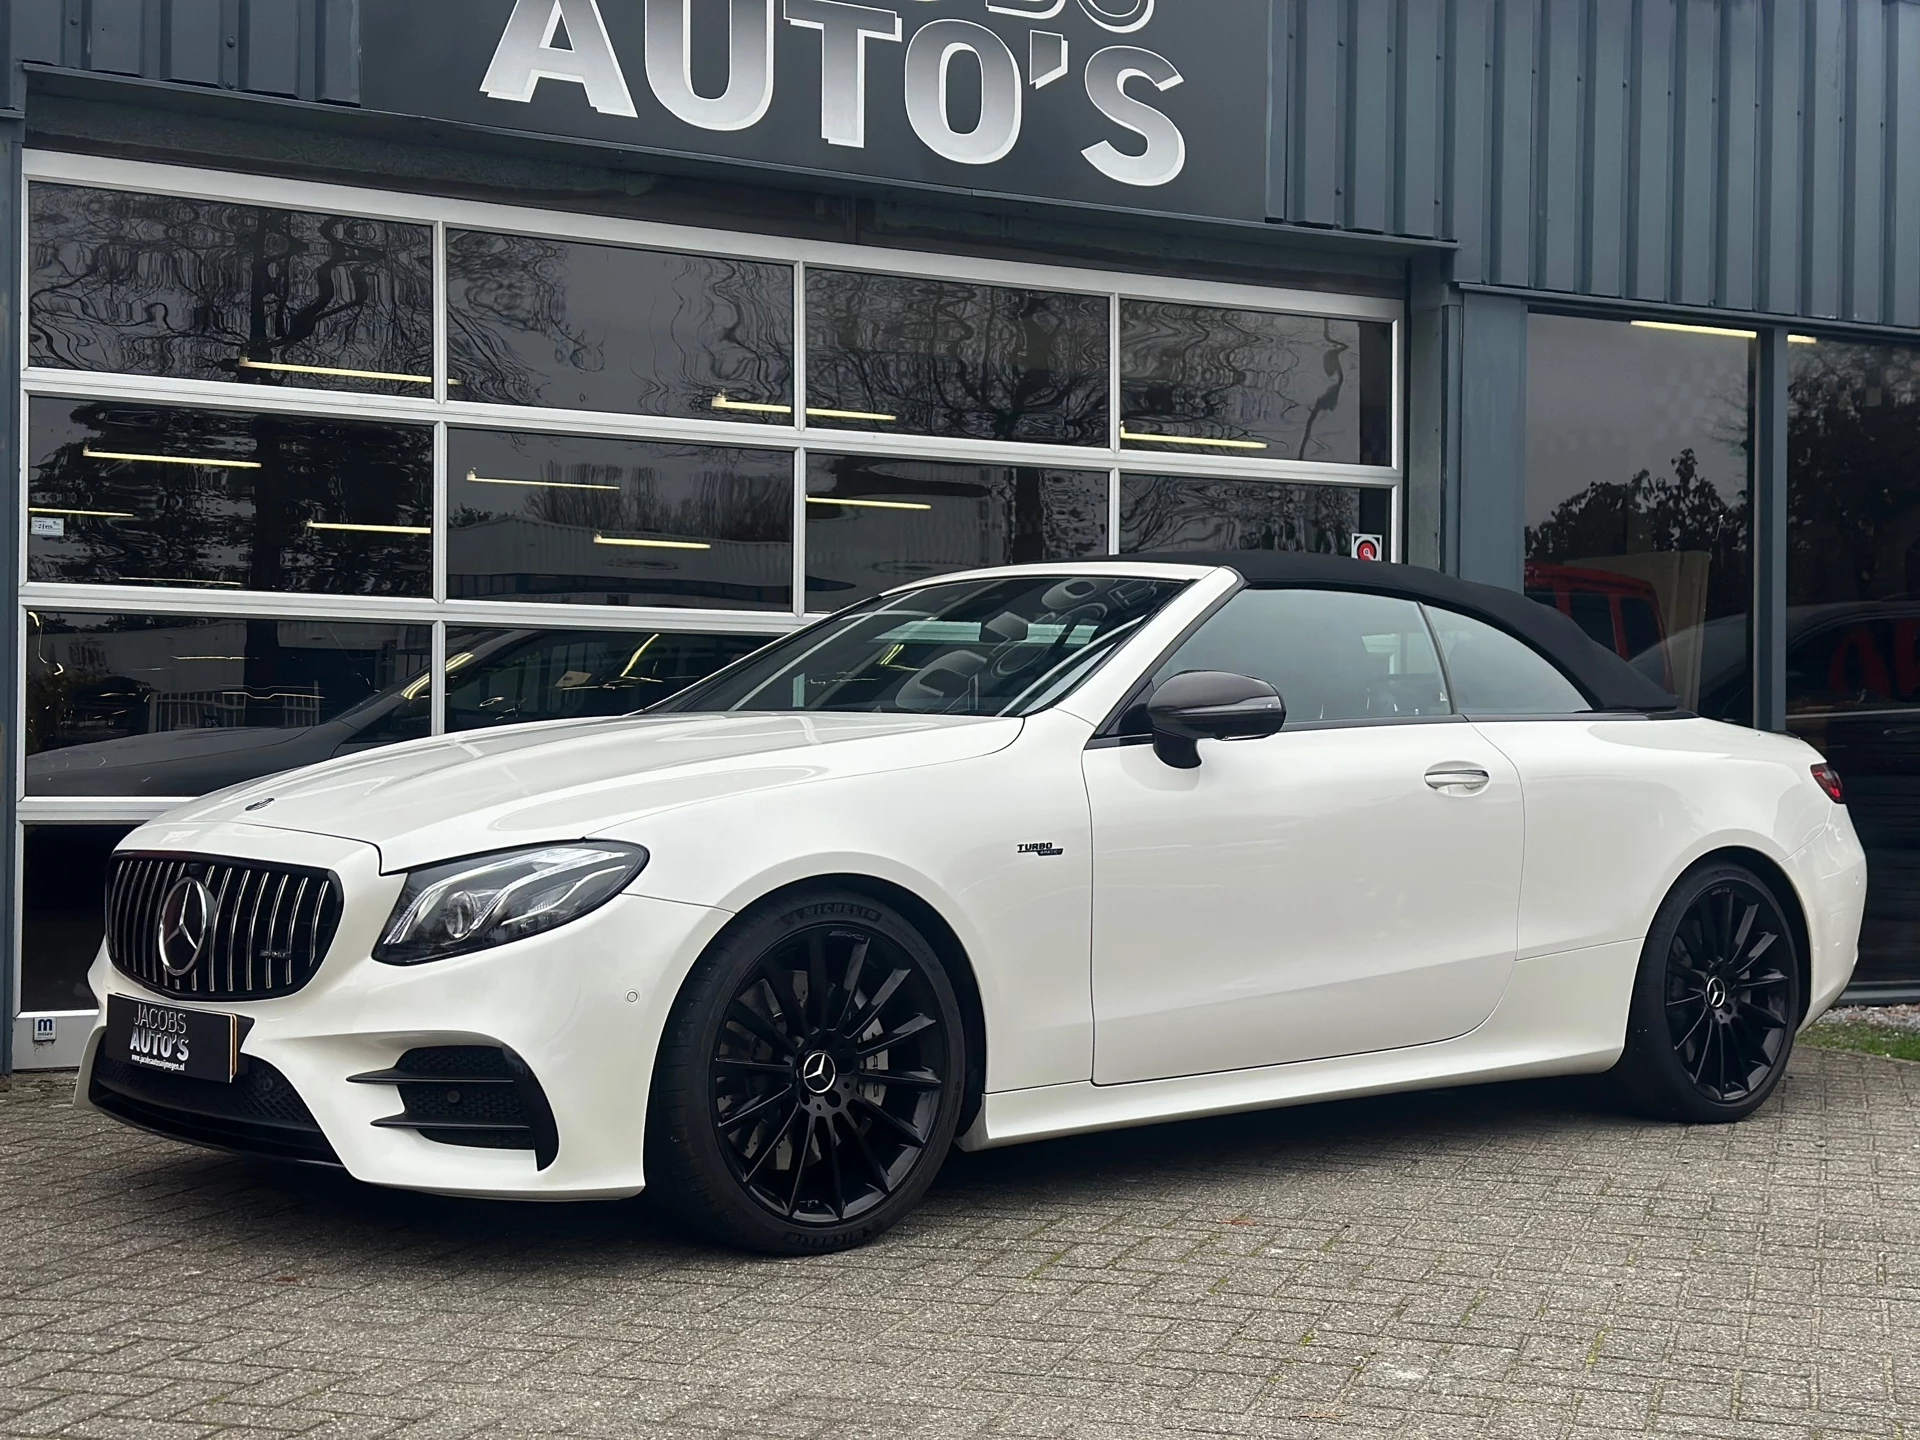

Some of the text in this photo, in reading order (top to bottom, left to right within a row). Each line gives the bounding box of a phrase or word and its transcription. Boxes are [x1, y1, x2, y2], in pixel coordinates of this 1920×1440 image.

[479, 0, 1186, 187] AUTO'S
[1017, 841, 1053, 850] TURBO
[803, 903, 877, 920] MICHELIN
[133, 1003, 187, 1034] JACOBS
[129, 1026, 189, 1061] AUTO'S
